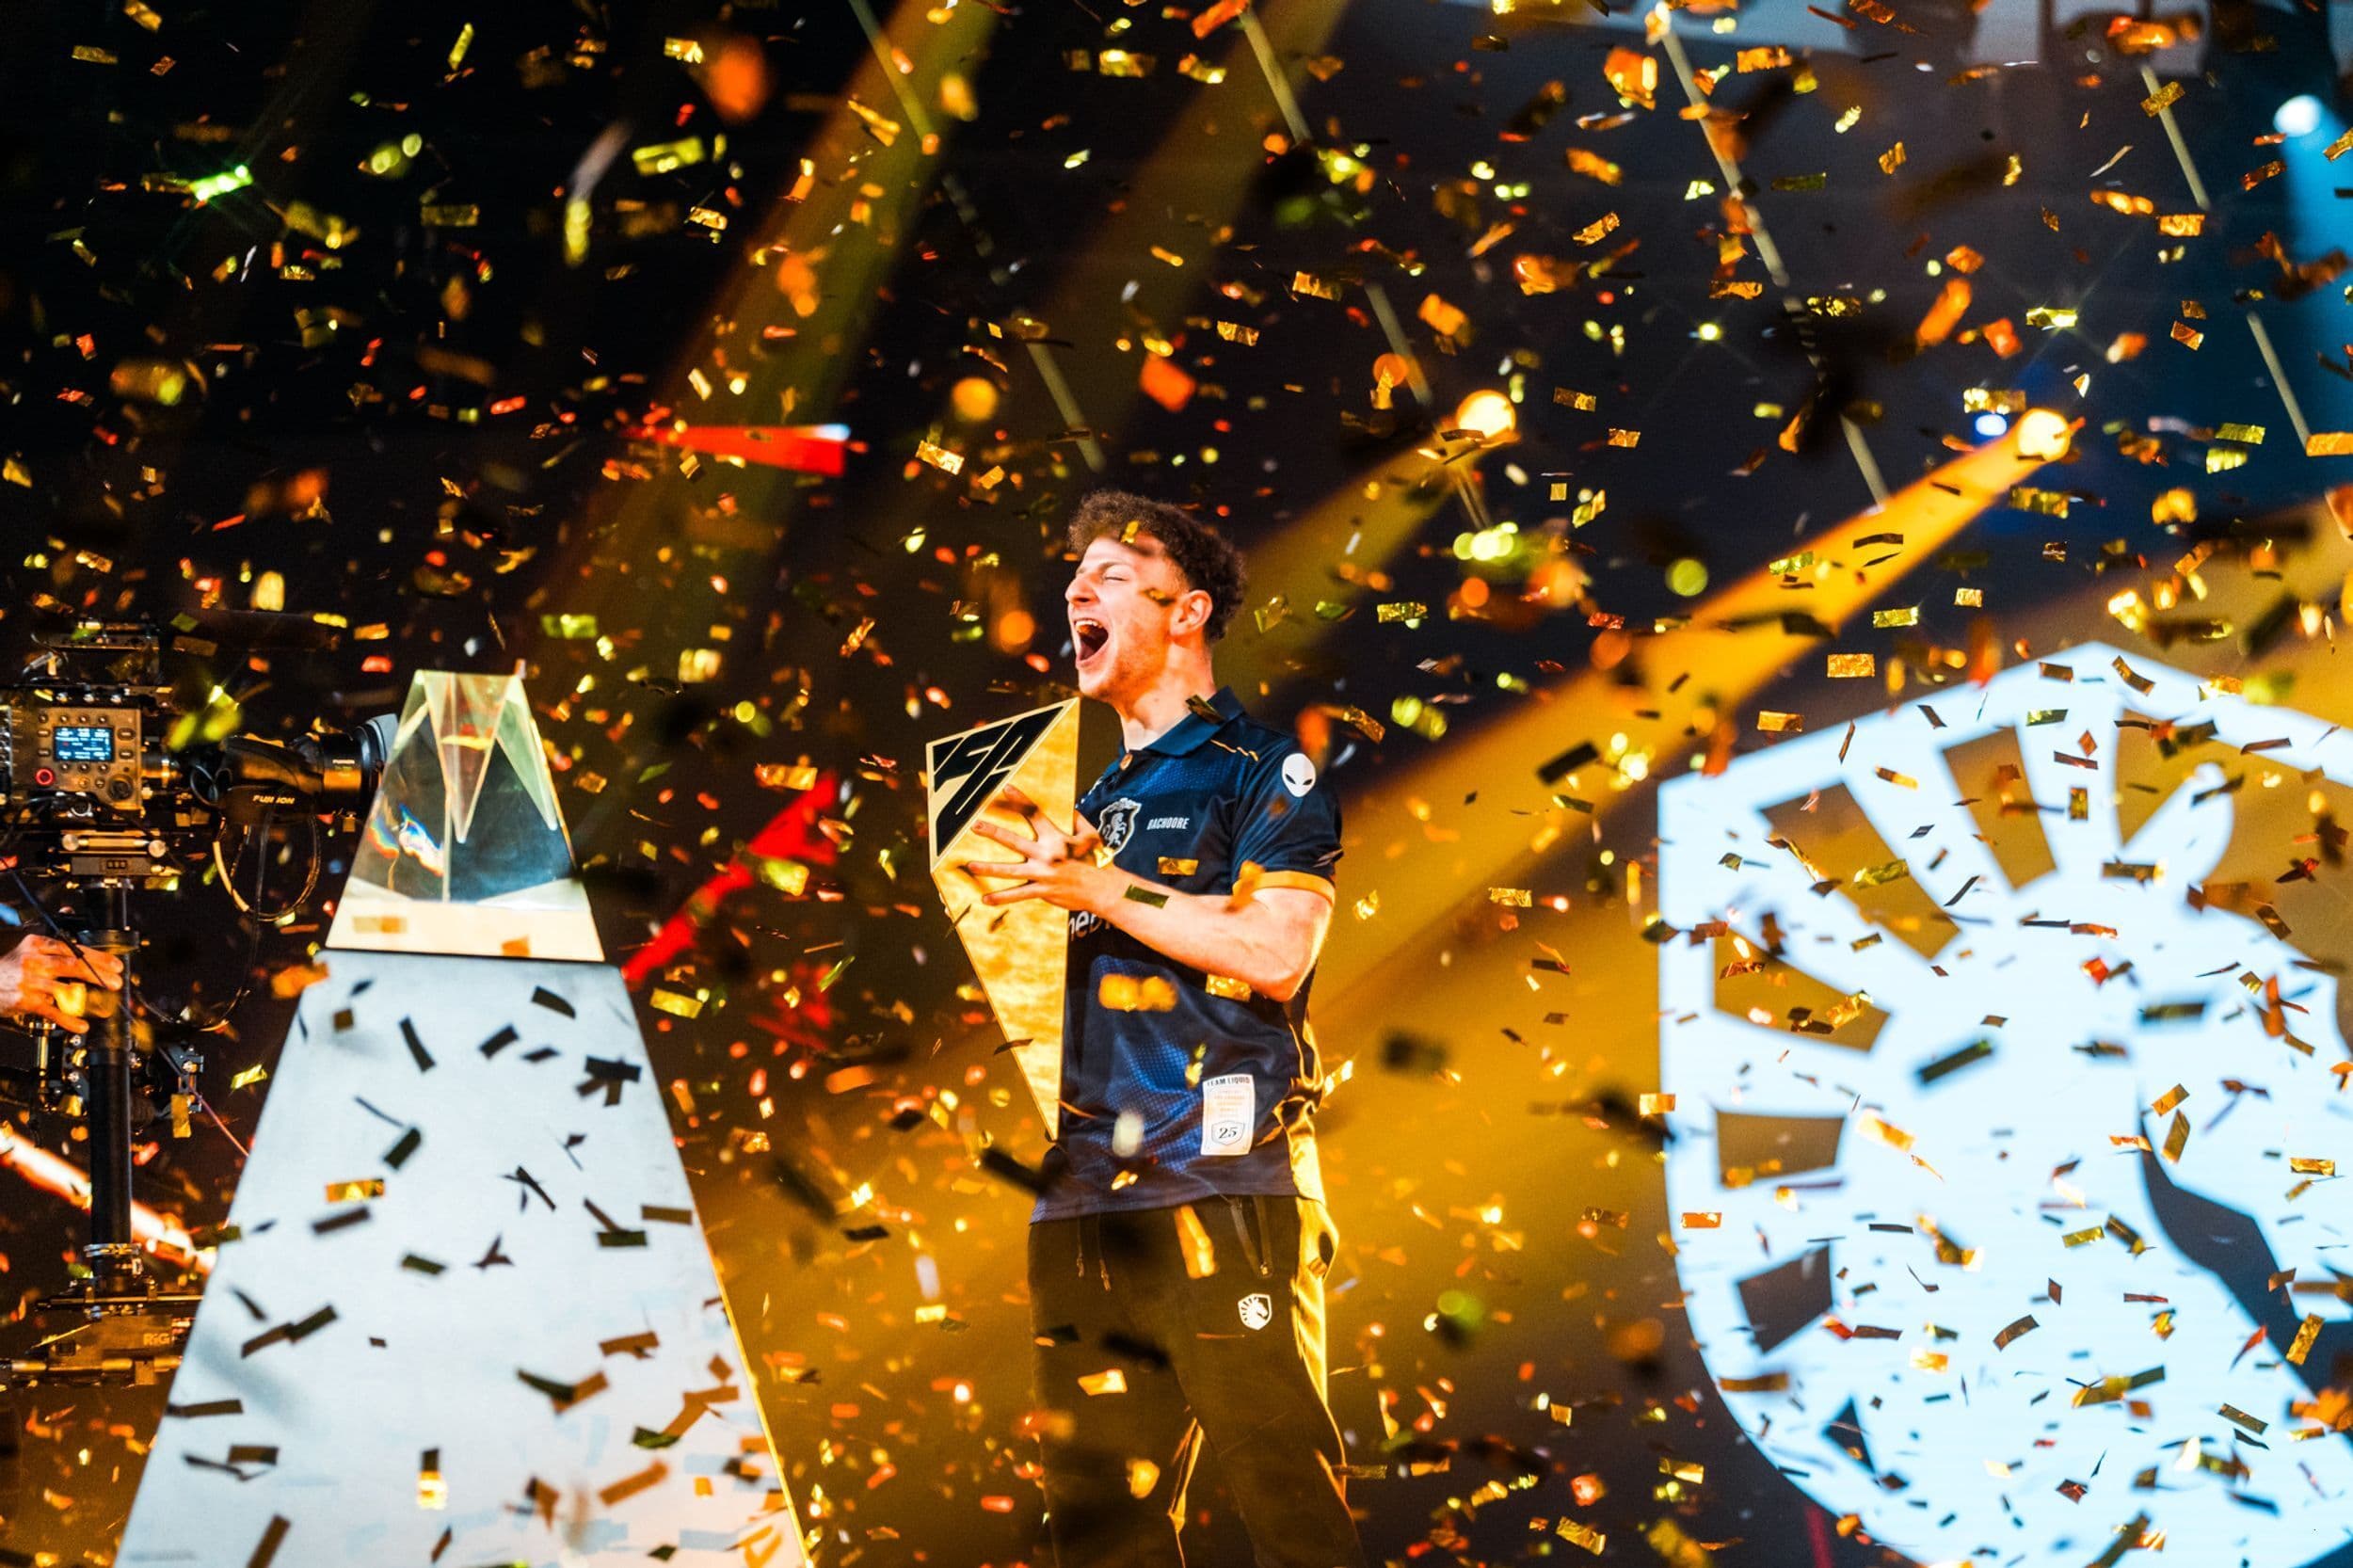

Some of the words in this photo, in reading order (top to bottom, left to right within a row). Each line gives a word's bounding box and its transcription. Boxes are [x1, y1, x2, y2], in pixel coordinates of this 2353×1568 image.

[1207, 1078, 1226, 1087] TEAM
[1227, 1076, 1251, 1084] LIQUID
[1218, 1127, 1239, 1139] 25
